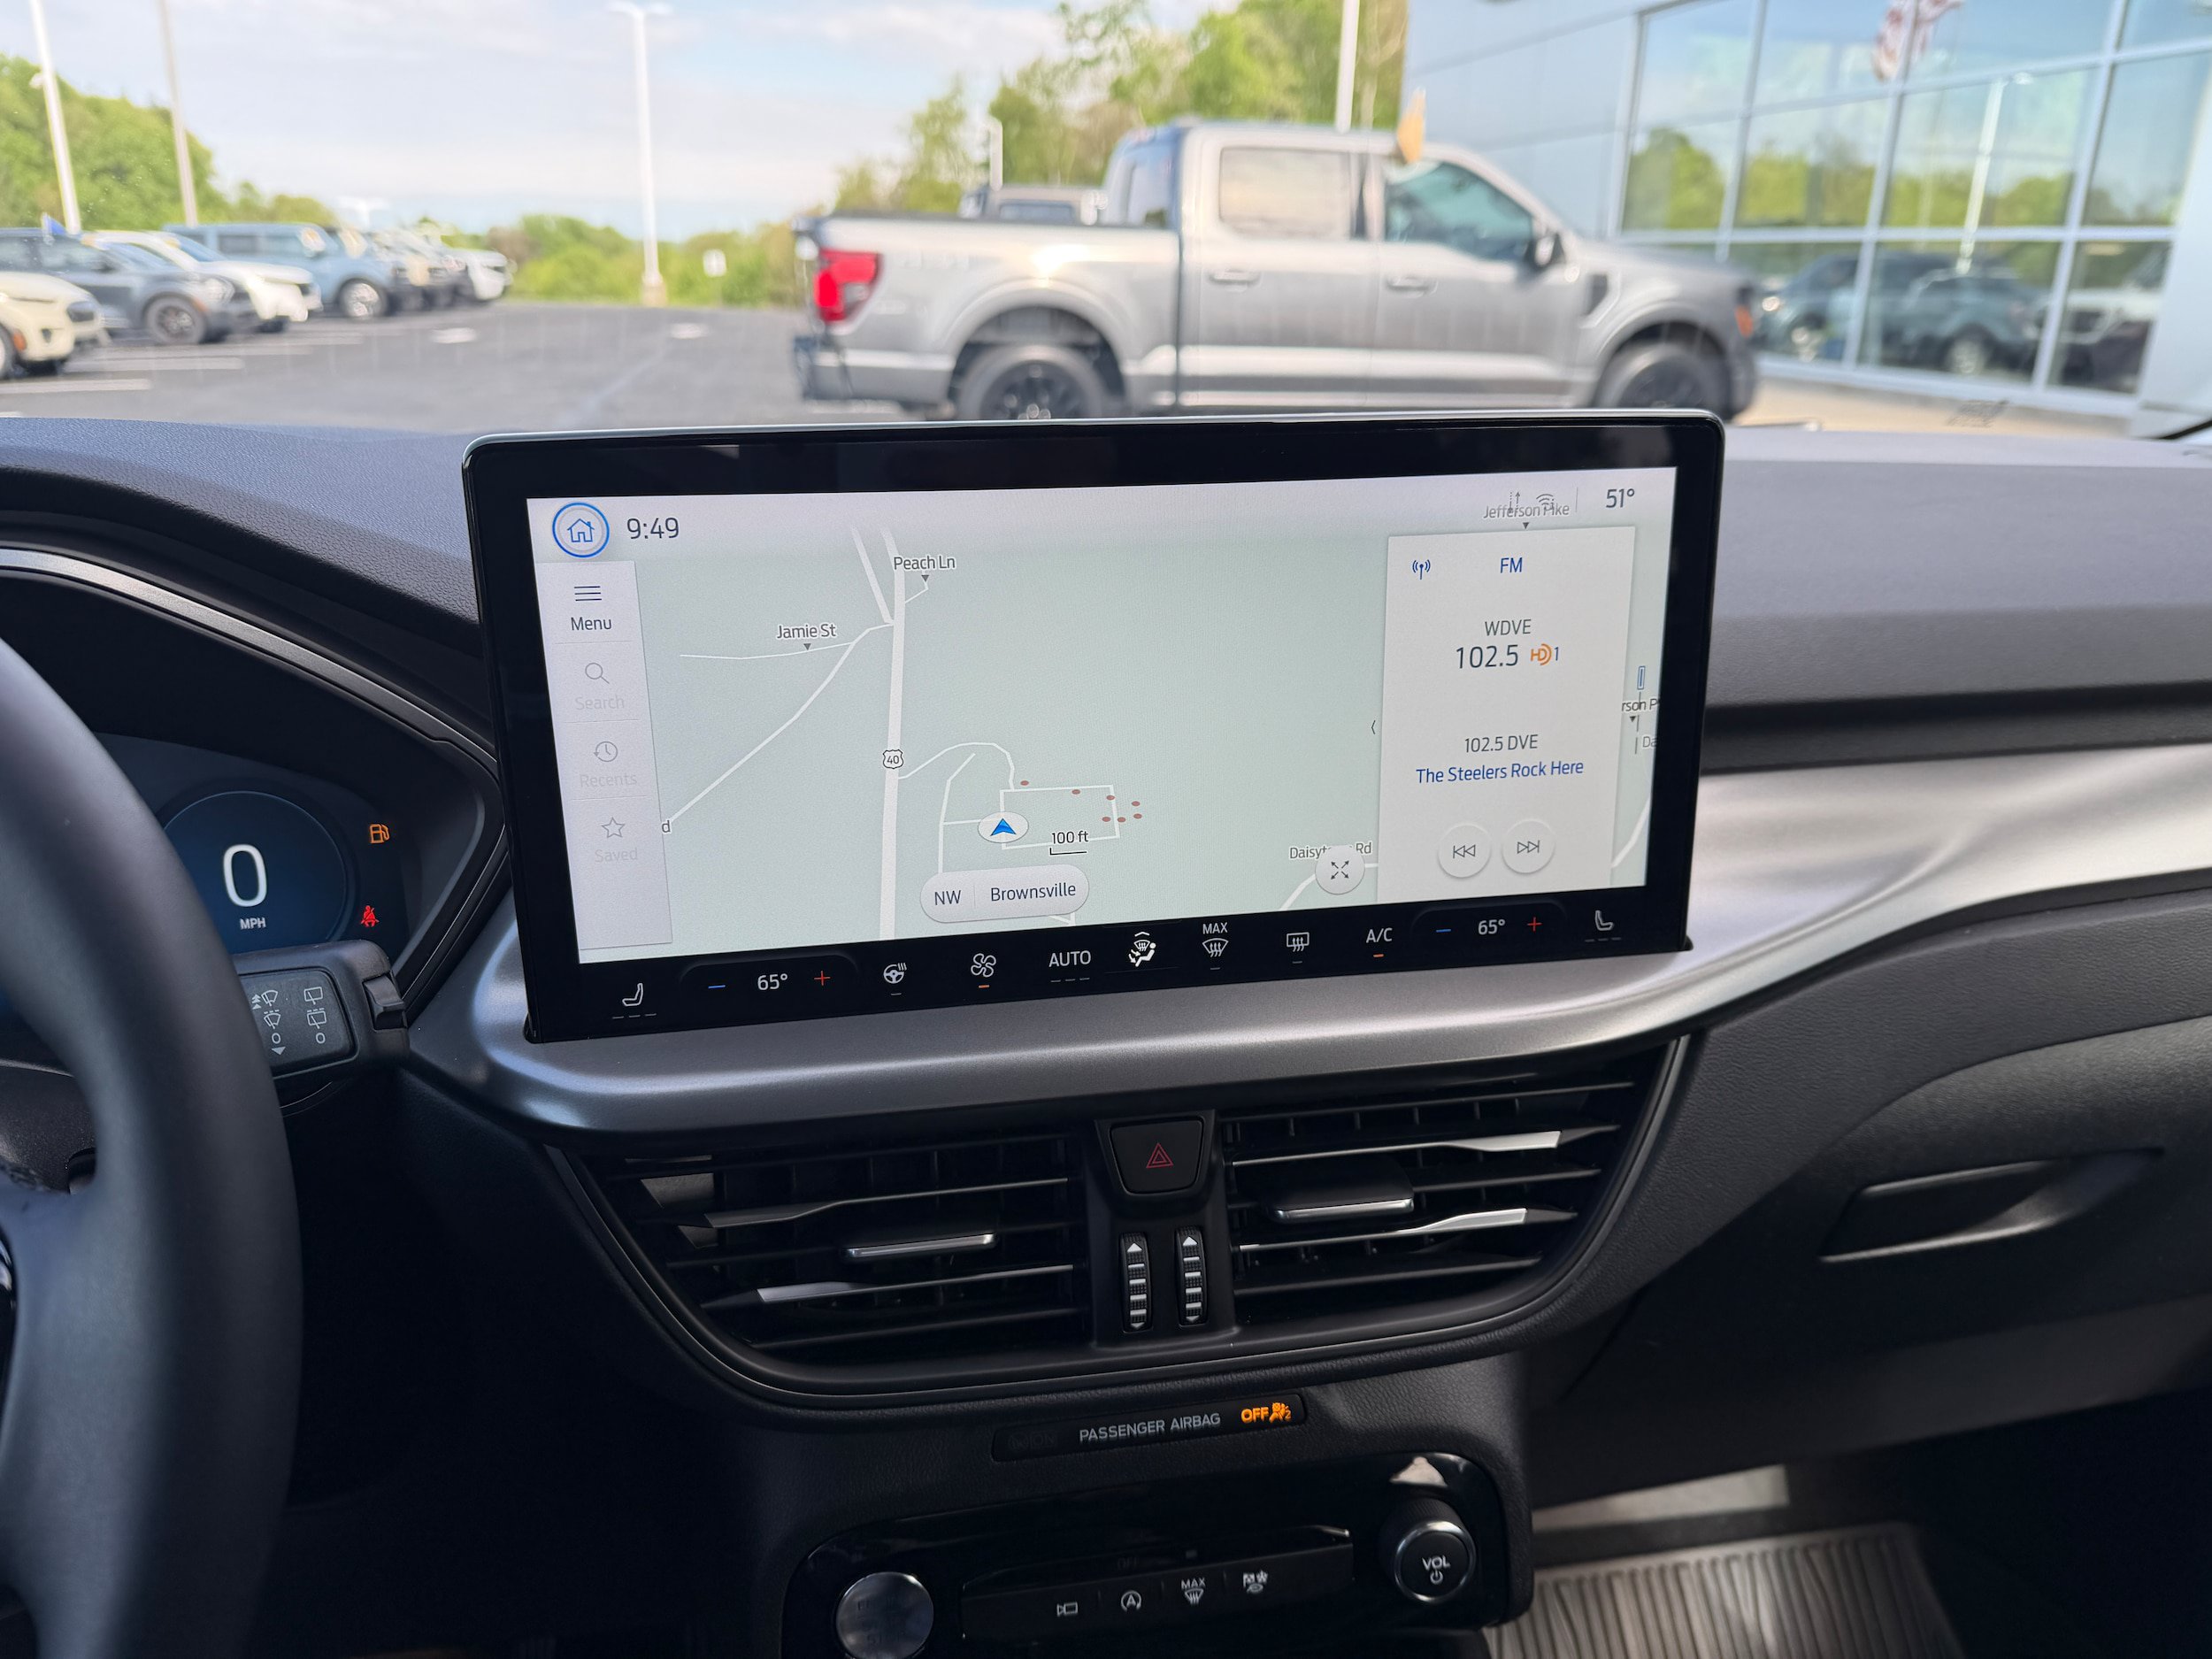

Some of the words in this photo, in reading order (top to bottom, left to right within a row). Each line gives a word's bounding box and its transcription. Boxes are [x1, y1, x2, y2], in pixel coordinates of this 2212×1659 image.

[1605, 488, 1635, 509] 51°
[1483, 504, 1540, 519] Jefferson
[626, 516, 680, 541] 9:49
[893, 555, 936, 571] Peach
[939, 555, 956, 569] Ln
[1499, 557, 1524, 573] FM
[571, 616, 612, 634] Menu
[777, 625, 818, 639] Jamie
[820, 623, 836, 637] St
[1485, 618, 1532, 636] WDVE
[1455, 644, 1518, 669] 102.5
[575, 694, 626, 711] Search
[1464, 736, 1503, 753] 102.5
[1507, 734, 1539, 751] DVE
[887, 755, 899, 764] 40
[579, 772, 638, 787] Recents
[1416, 767, 1444, 784] The
[1448, 764, 1508, 782] Steelers
[1510, 761, 1547, 780] Rock
[1550, 759, 1584, 776] Here
[1051, 831, 1075, 845] 100
[1078, 830, 1089, 843] ft
[595, 847, 639, 864] Saved
[1356, 841, 1371, 855] Rd
[222, 843, 267, 908] 0
[934, 889, 962, 905] NW
[990, 882, 1077, 902] Brownsville
[239, 917, 266, 930] MPH
[1202, 921, 1228, 935] MAX
[1478, 918, 1506, 935] 65°
[1365, 927, 1393, 944] A/C
[1048, 949, 1092, 968] AUTO
[757, 972, 788, 991] 65°
[1240, 1406, 1270, 1424] OFF
[1079, 1419, 1165, 1443] PASSENGER
[1170, 1412, 1221, 1431] AIRBAG
[1421, 1555, 1451, 1571] VOL
[1180, 1577, 1206, 1590] MAX
